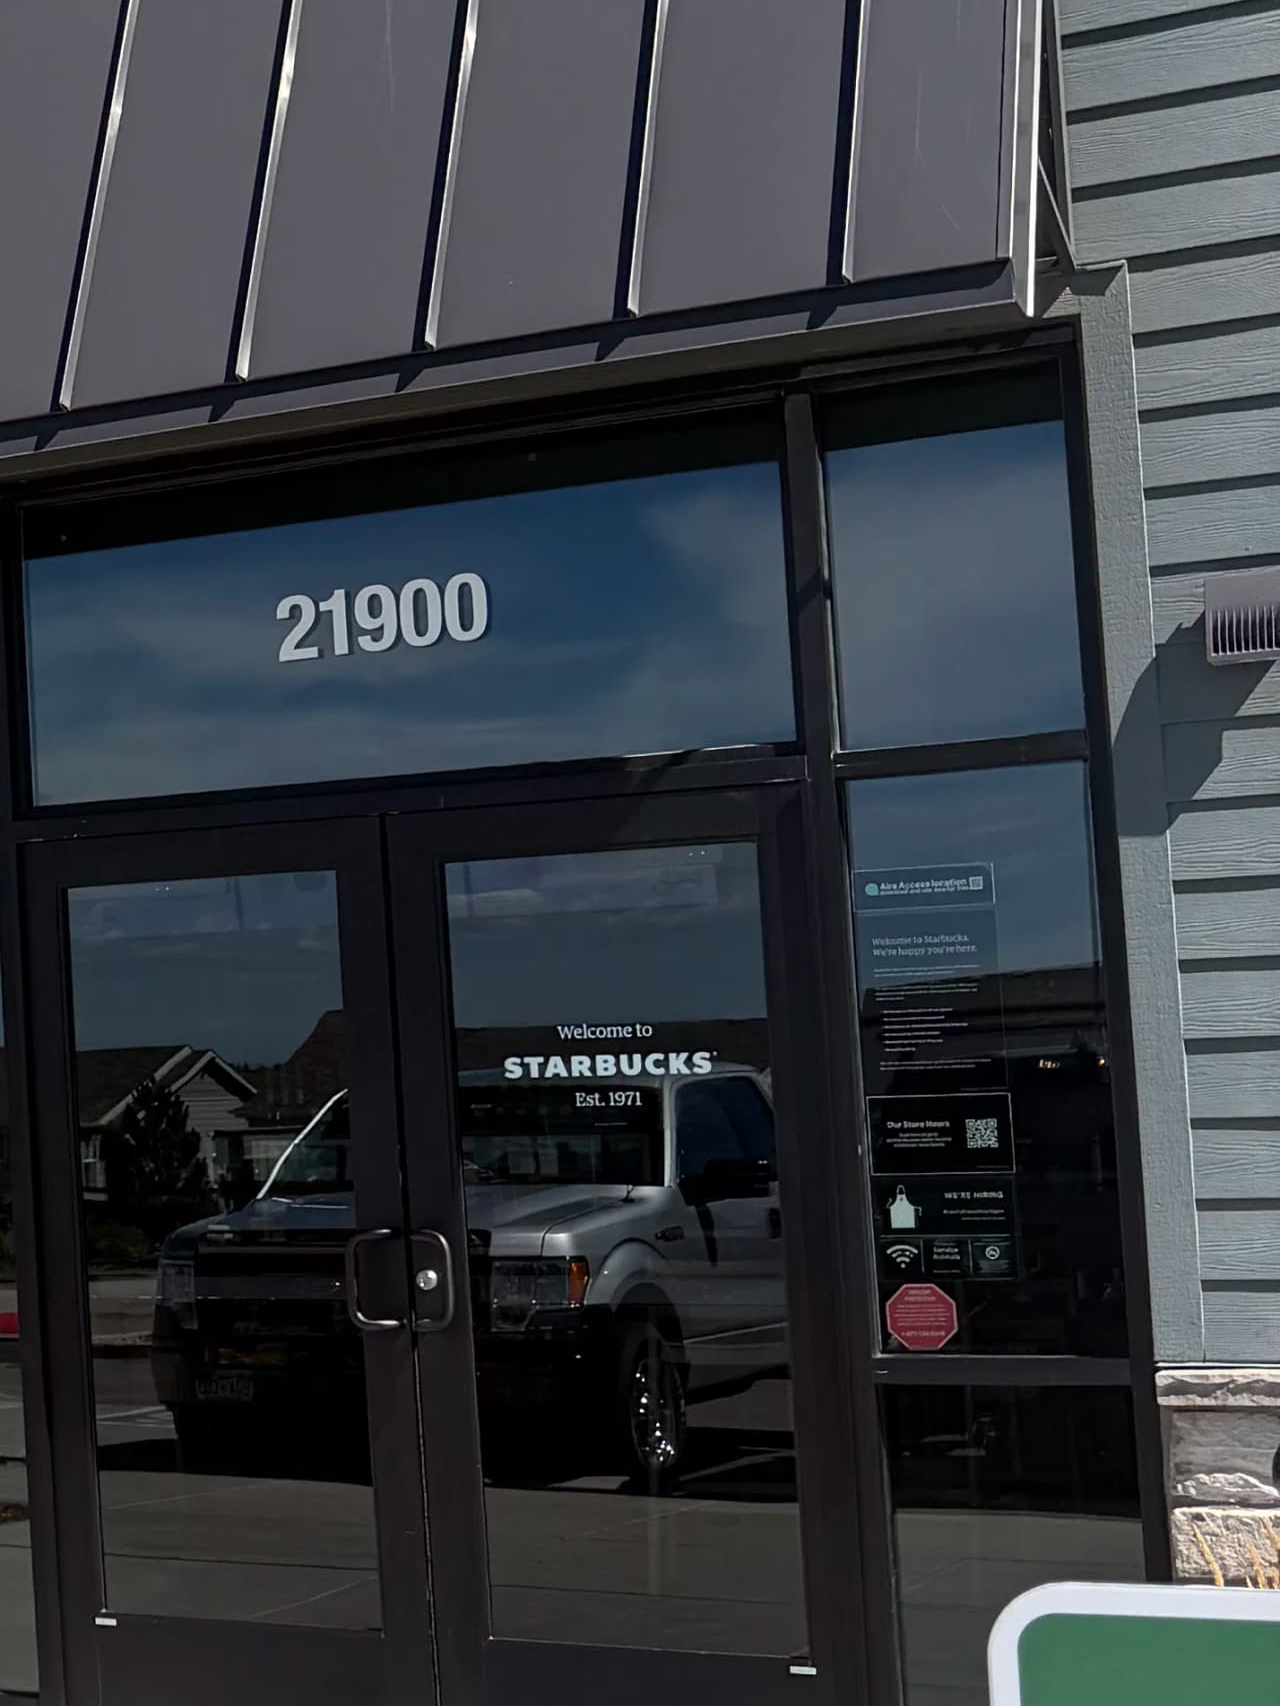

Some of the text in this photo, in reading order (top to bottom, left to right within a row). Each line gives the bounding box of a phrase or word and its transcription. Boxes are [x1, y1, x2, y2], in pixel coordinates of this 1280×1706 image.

[275, 572, 488, 662] 21900
[557, 1023, 653, 1039] Welcome to
[503, 1051, 713, 1080] STARBUCKS
[575, 1092, 643, 1107] Est. 1971
